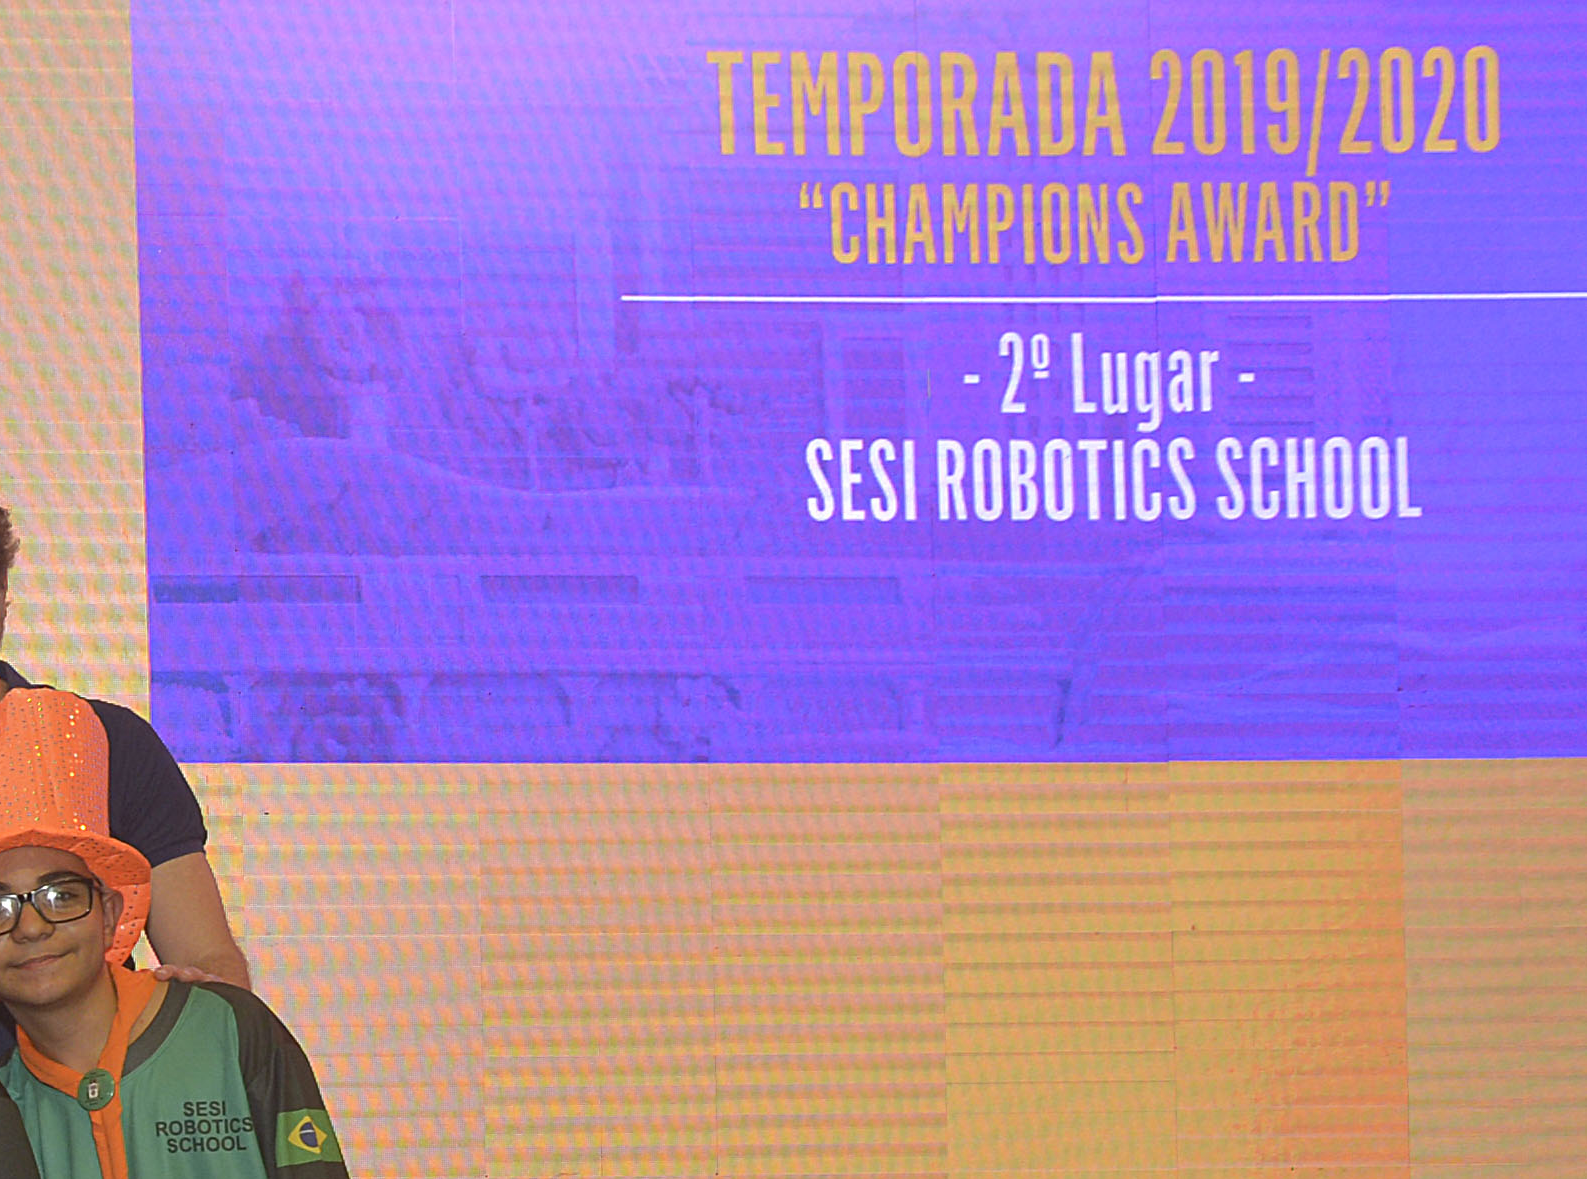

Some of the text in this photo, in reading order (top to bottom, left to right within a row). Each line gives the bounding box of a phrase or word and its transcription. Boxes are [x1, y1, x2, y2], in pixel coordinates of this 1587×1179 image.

[707, 45, 1501, 176] TEMPORADA 2019/2020
[1073, 332, 1219, 433] Lugar
[806, 435, 1422, 523] SESI ROBOTICS SCHOOL
[155, 1117, 253, 1137] ROBOTICS
[183, 1100, 226, 1117] SESI
[167, 1136, 247, 1153] SCHOOL
